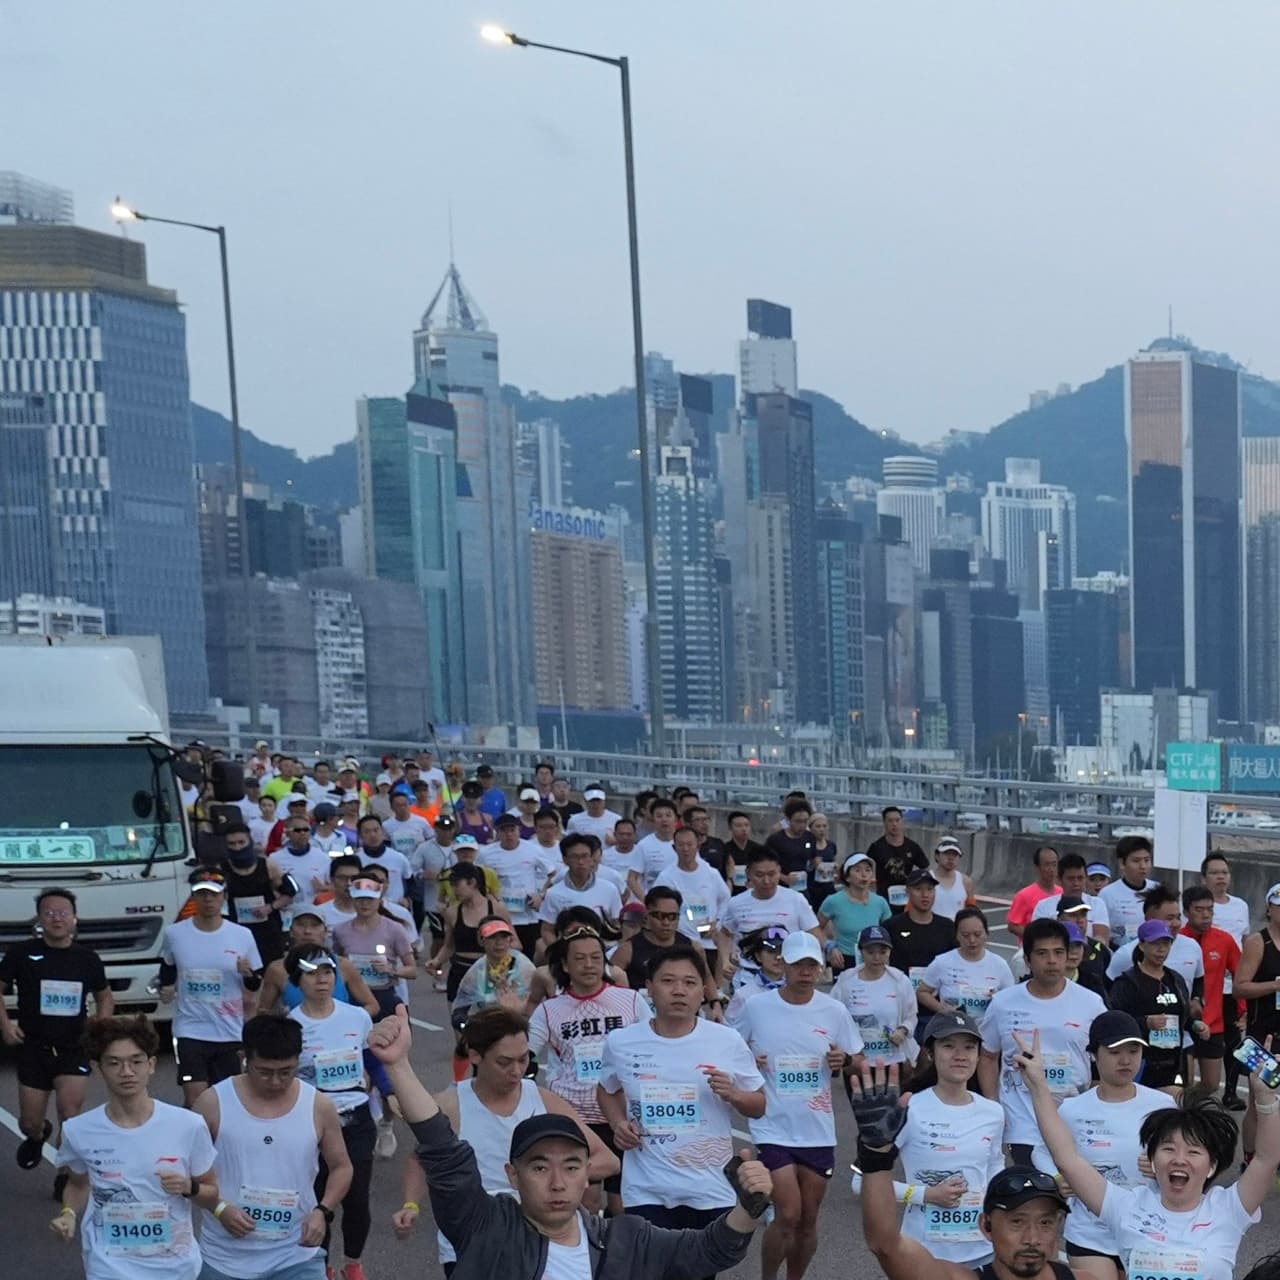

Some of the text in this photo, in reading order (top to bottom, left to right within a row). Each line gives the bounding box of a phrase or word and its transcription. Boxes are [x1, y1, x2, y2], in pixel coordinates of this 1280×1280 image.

[1170, 752, 1193, 767] CTF
[125, 905, 165, 915] 500
[186, 981, 221, 994] 32550
[961, 997, 986, 1008] 3800
[863, 1040, 890, 1051] 8022
[321, 1063, 357, 1079] 32014
[581, 1060, 603, 1072] 312
[778, 1071, 819, 1084] 30835
[1043, 1068, 1065, 1079] 199
[645, 1104, 696, 1118] 38045
[930, 1210, 979, 1224] 38687
[111, 1222, 164, 1239] 31406
